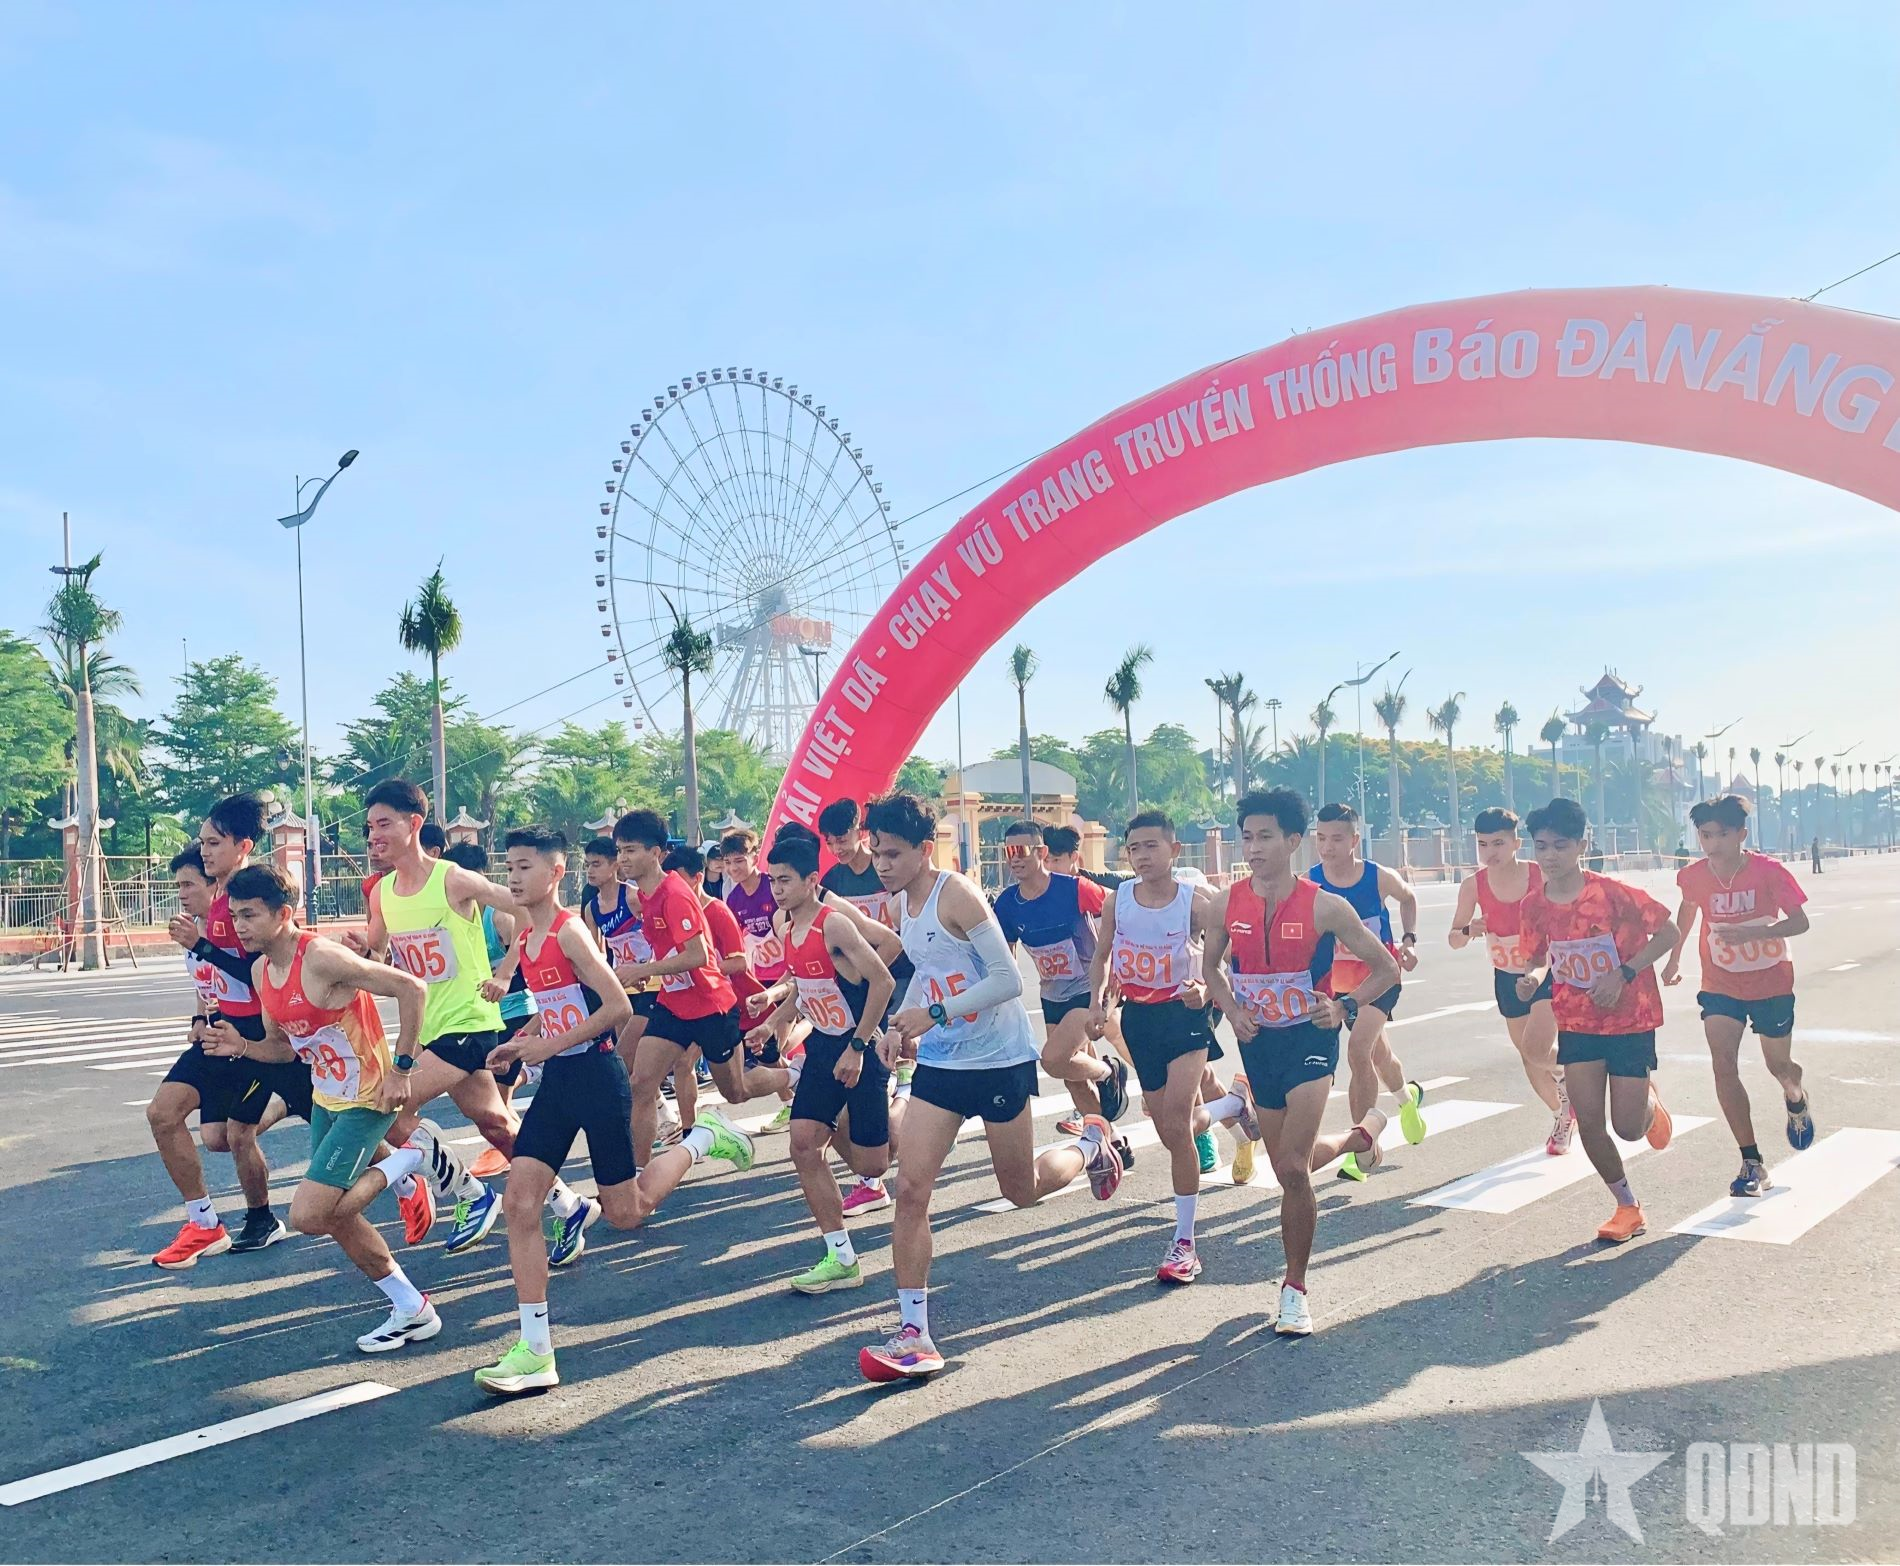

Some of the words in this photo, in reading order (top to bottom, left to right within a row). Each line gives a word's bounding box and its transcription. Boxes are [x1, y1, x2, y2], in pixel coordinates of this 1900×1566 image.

[779, 779, 822, 826] ẢI
[801, 705, 855, 780] VIỆT
[841, 656, 888, 712] DÃ
[876, 645, 887, 659] -
[889, 561, 962, 650] CHẠY
[956, 518, 1004, 577] VŨ
[1002, 449, 1115, 542] TRANG
[1114, 378, 1256, 476] TRUYỀN
[1263, 340, 1398, 420] THỐNG
[1413, 318, 1540, 385] Báo
[1710, 889, 1756, 914] RUN
[1117, 948, 1172, 984] 391
